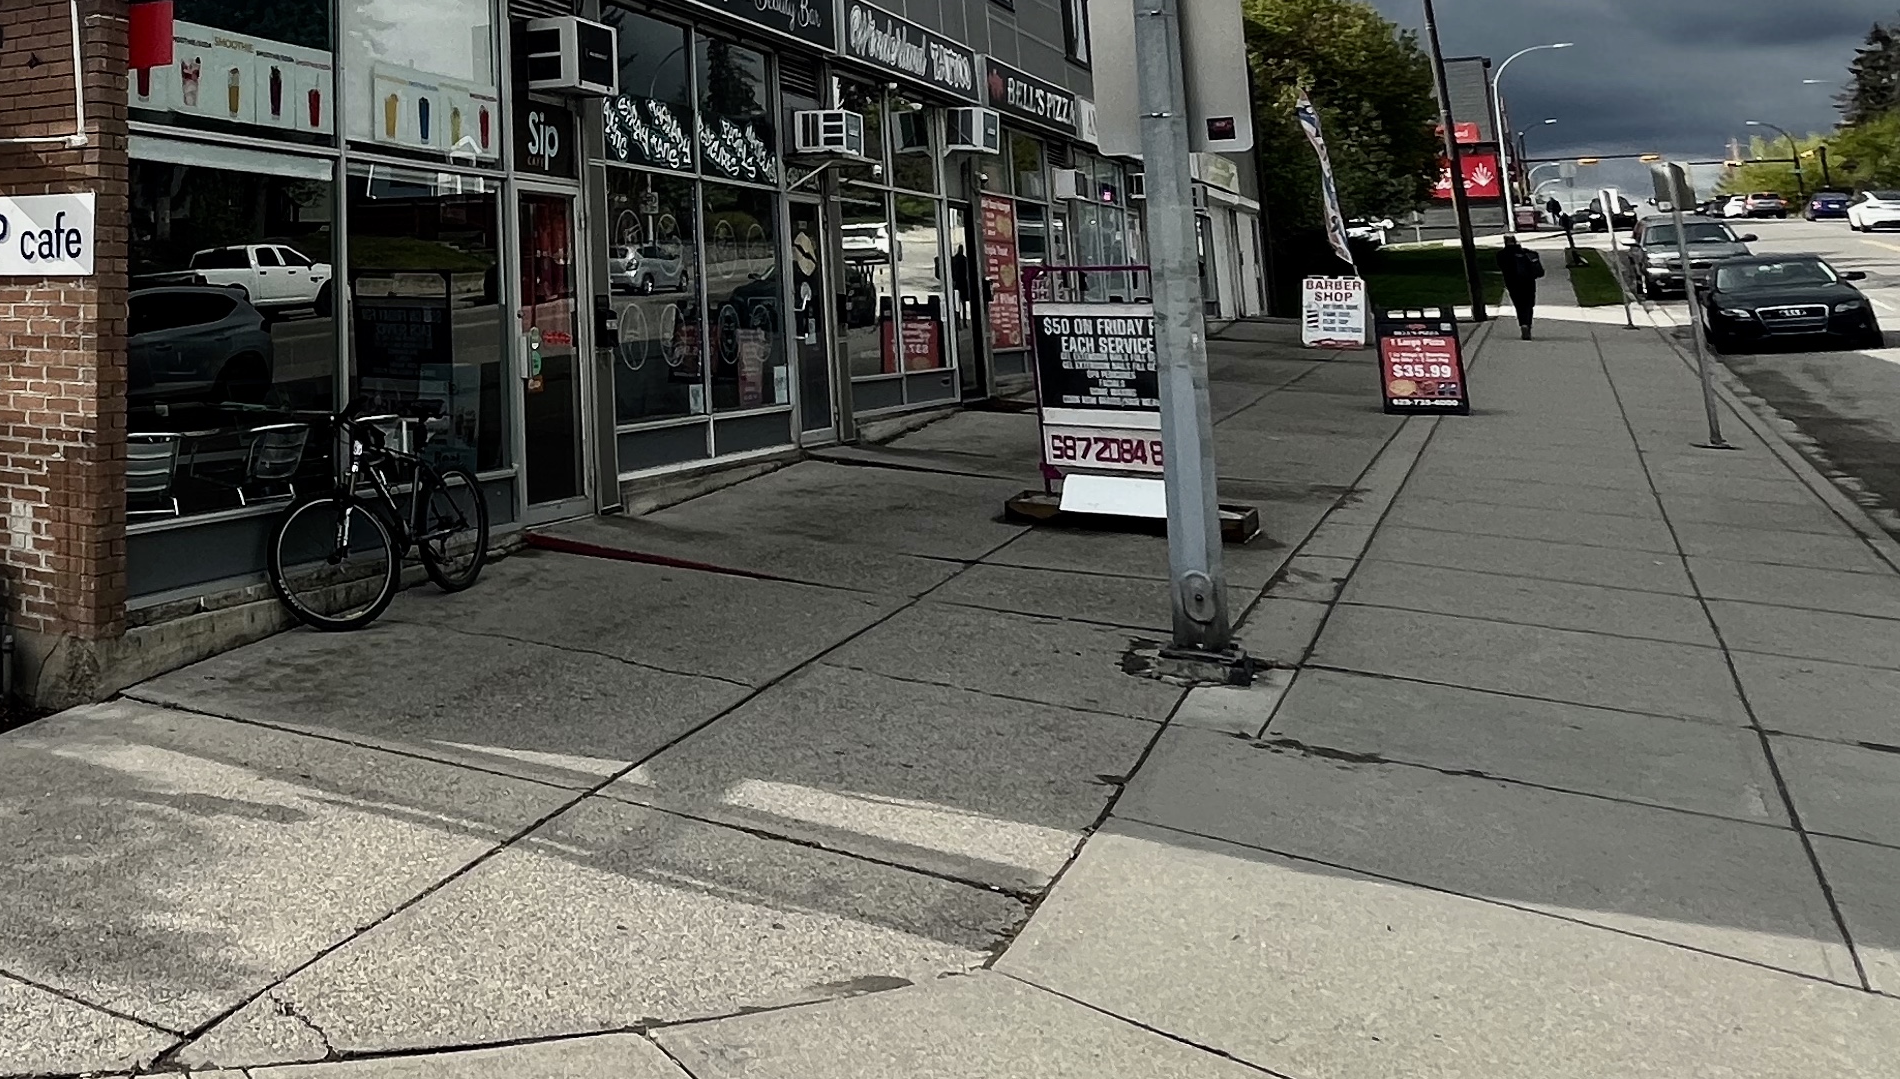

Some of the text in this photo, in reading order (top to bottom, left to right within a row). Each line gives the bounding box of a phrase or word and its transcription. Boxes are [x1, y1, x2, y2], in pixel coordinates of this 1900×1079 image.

[1006, 76, 1045, 116] BELL'S
[1046, 89, 1077, 126] PIZZA
[527, 110, 559, 171] Sip
[19, 209, 82, 262] cafe
[1305, 280, 1362, 291] BARBER
[1314, 291, 1353, 302] SHOP
[1042, 316, 1071, 336] $50
[1073, 318, 1094, 335] ON
[1096, 318, 1144, 336] FRIDAY
[1060, 336, 1155, 355] EACH SERVICE
[1392, 363, 1452, 378] $35.99
